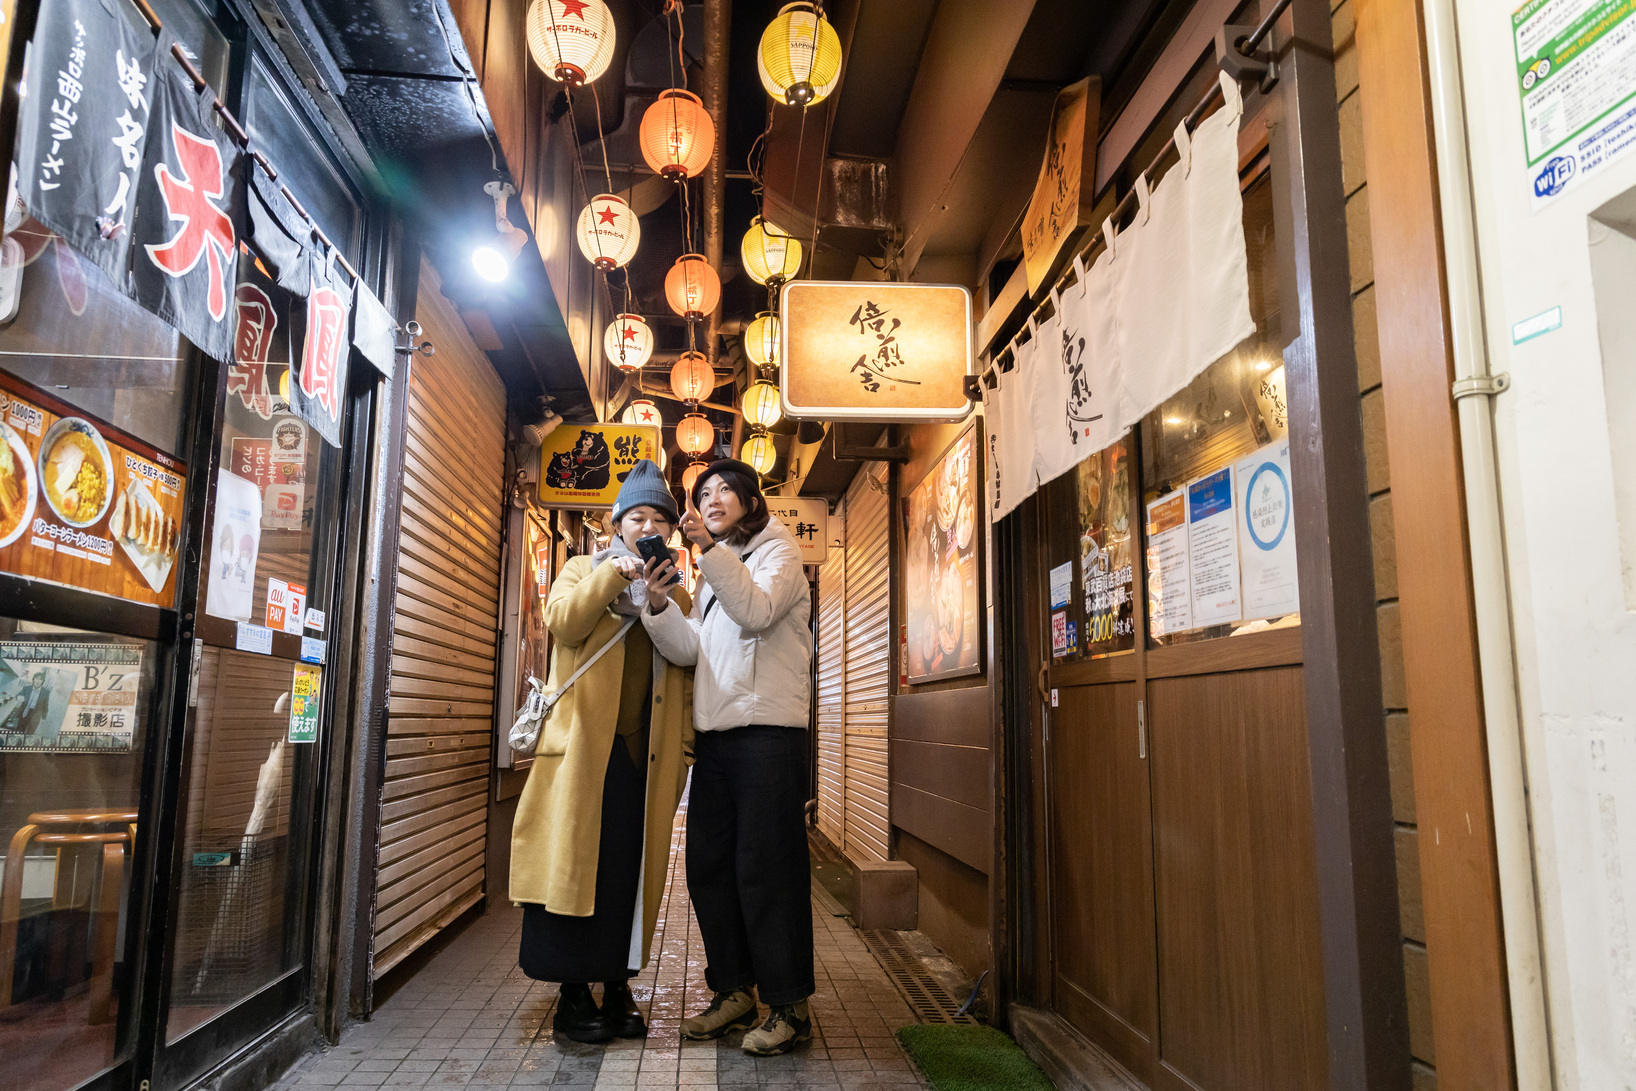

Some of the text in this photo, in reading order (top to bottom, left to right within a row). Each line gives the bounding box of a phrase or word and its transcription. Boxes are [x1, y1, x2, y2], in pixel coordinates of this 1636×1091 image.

[39, 18, 87, 191] サッポロ西山ラーメン
[126, 456, 158, 480] ひとくち餃子
[271, 510, 299, 520] PayPay
[33, 519, 88, 548] バターコーンラーメン
[271, 589, 284, 603] au
[270, 606, 283, 622] PAY
[1053, 616, 1065, 632] FREE
[1089, 613, 1113, 643] 5000
[76, 712, 125, 728] 撮影店
[292, 715, 316, 733] 使えます
